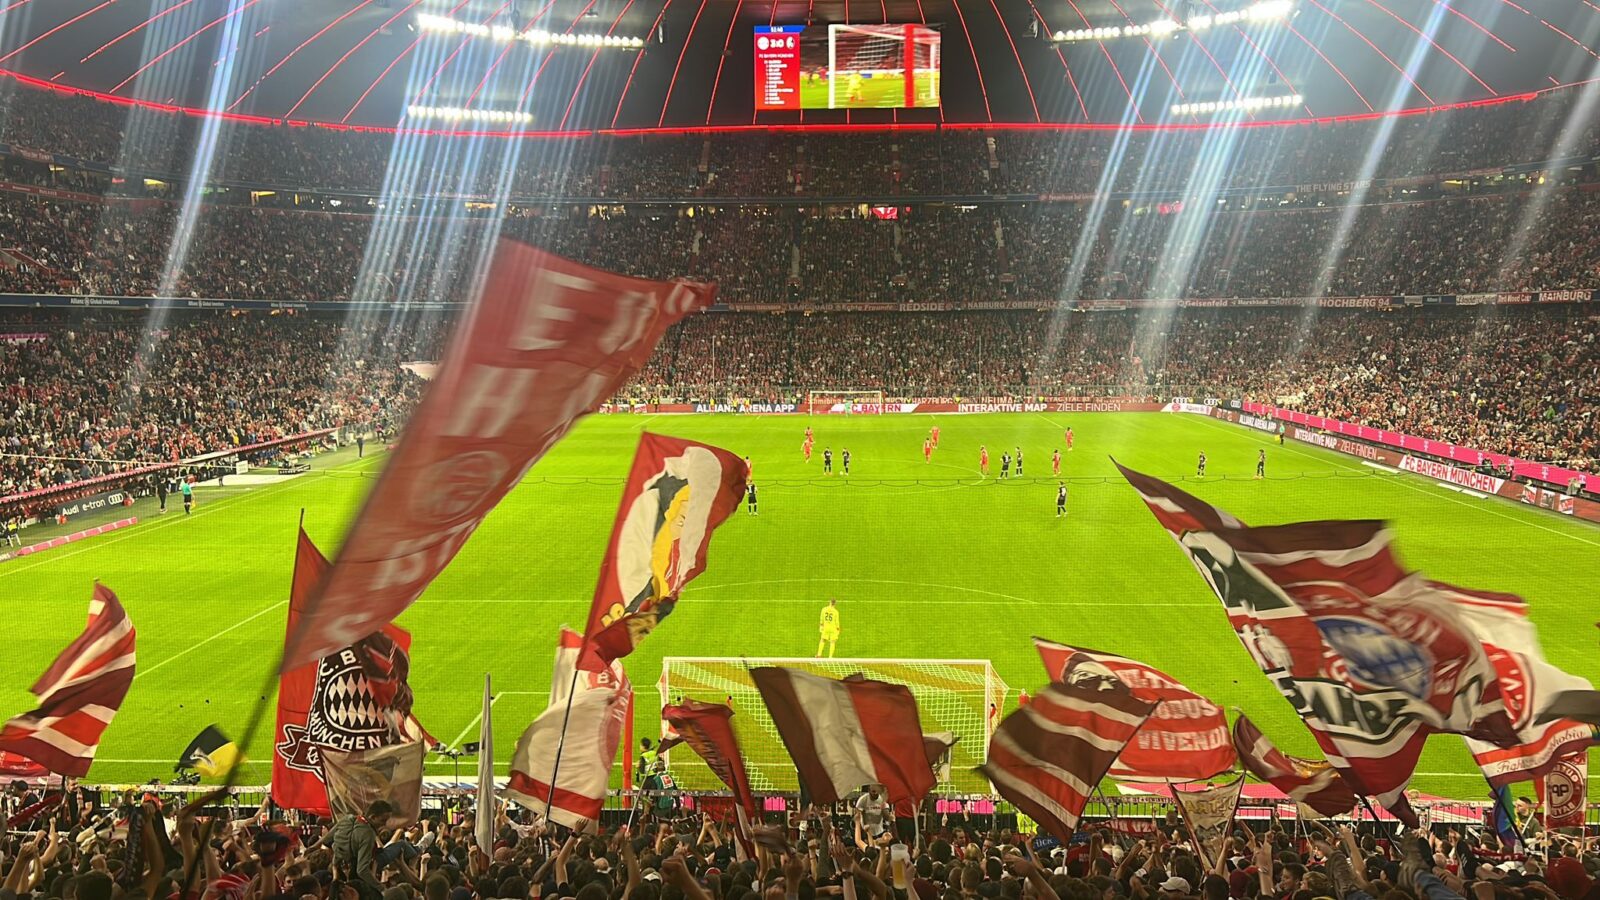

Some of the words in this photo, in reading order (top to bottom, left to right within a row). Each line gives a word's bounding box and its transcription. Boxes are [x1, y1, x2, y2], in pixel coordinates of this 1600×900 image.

[1539, 290, 1592, 302] MAINBURG
[899, 302, 945, 312] REDSIDE
[1319, 299, 1376, 308] HOCHBERG
[1378, 298, 1390, 307] 94
[740, 404, 772, 413] ARENA
[774, 404, 795, 413] APP
[958, 403, 1022, 412] INTERAKTIVE
[1024, 403, 1047, 412] MAP
[1056, 403, 1083, 412] ZIELE
[1085, 403, 1120, 412] FINDEN
[1405, 457, 1415, 469] FC
[1416, 460, 1448, 479] BAYERN
[1450, 463, 1496, 492] MÜNCHEN
[62, 507, 79, 515] Audi
[82, 499, 106, 510] e-tron
[825, 612, 833, 621] 26
[310, 711, 382, 750] MÜNCHEN
[1138, 726, 1229, 751] VIVENDI
